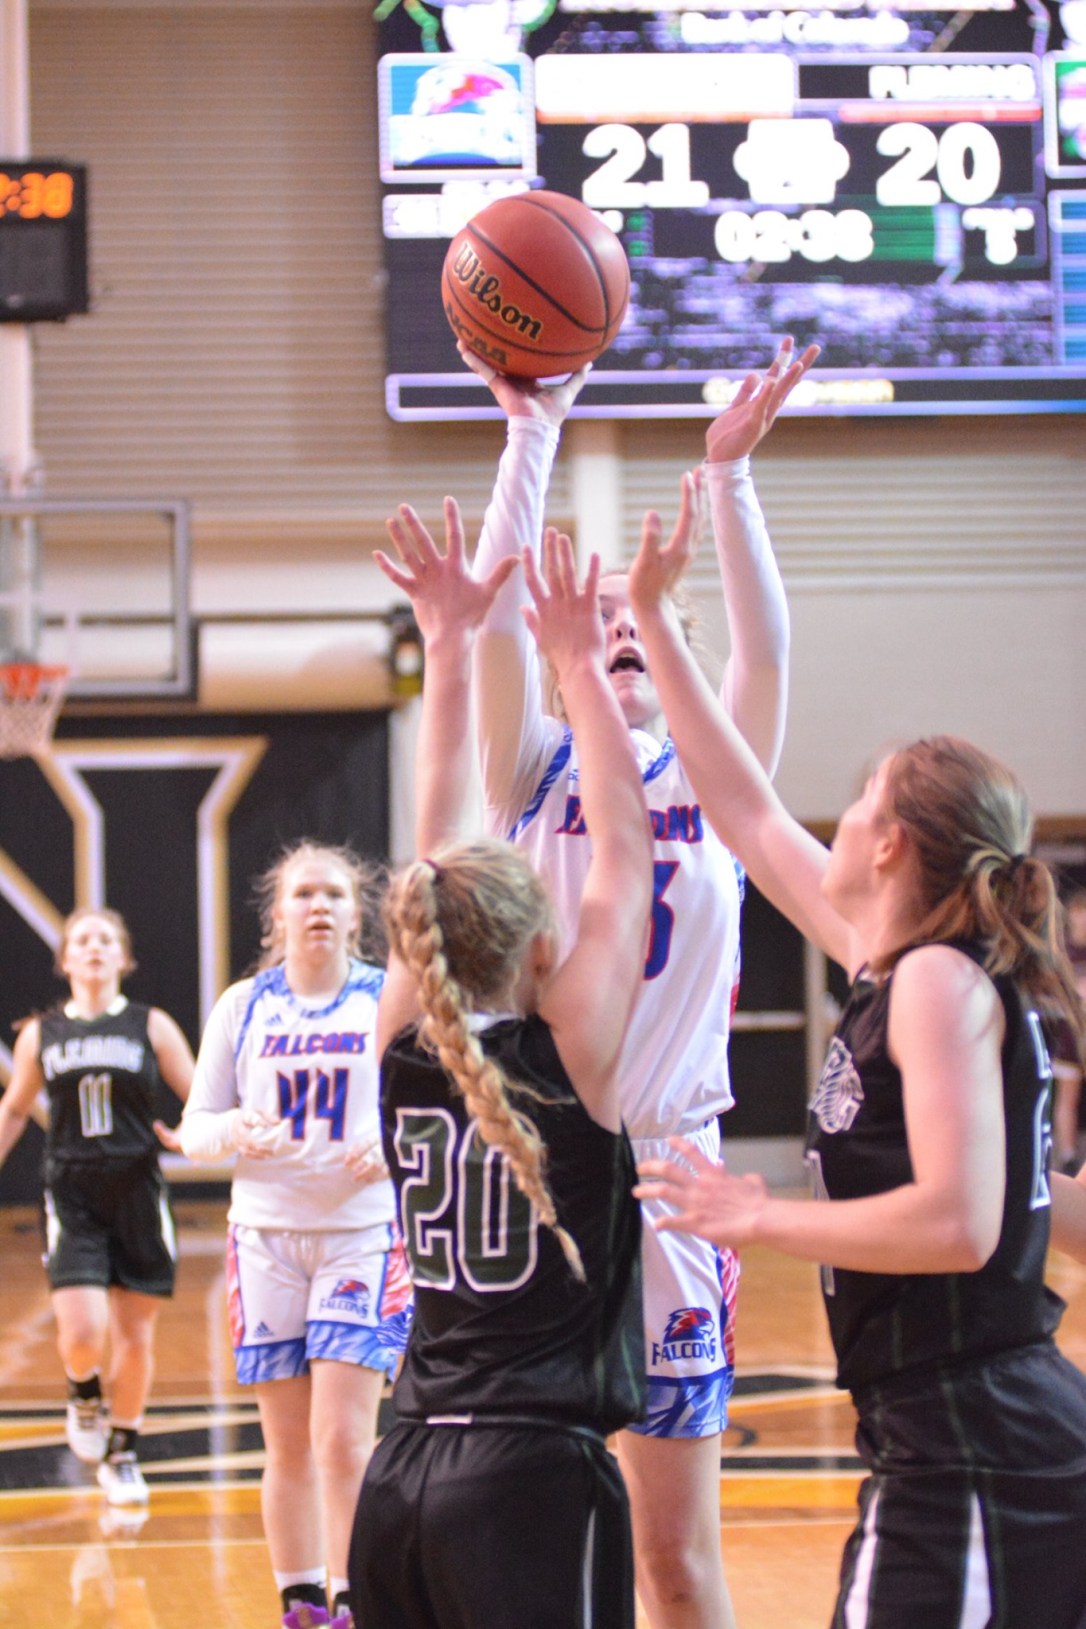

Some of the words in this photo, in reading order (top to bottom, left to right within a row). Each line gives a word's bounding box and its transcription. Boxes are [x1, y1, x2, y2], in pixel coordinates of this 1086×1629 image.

[582, 123, 709, 208] 21
[876, 122, 1001, 206] 20
[453, 242, 543, 340] Wilson
[554, 794, 702, 844] FONS
[258, 1030, 370, 1059] FALCONS
[78, 1072, 113, 1138] 11
[276, 1067, 350, 1142] 44
[394, 1107, 541, 1292] 20
[651, 1337, 716, 1366] FALCONS
